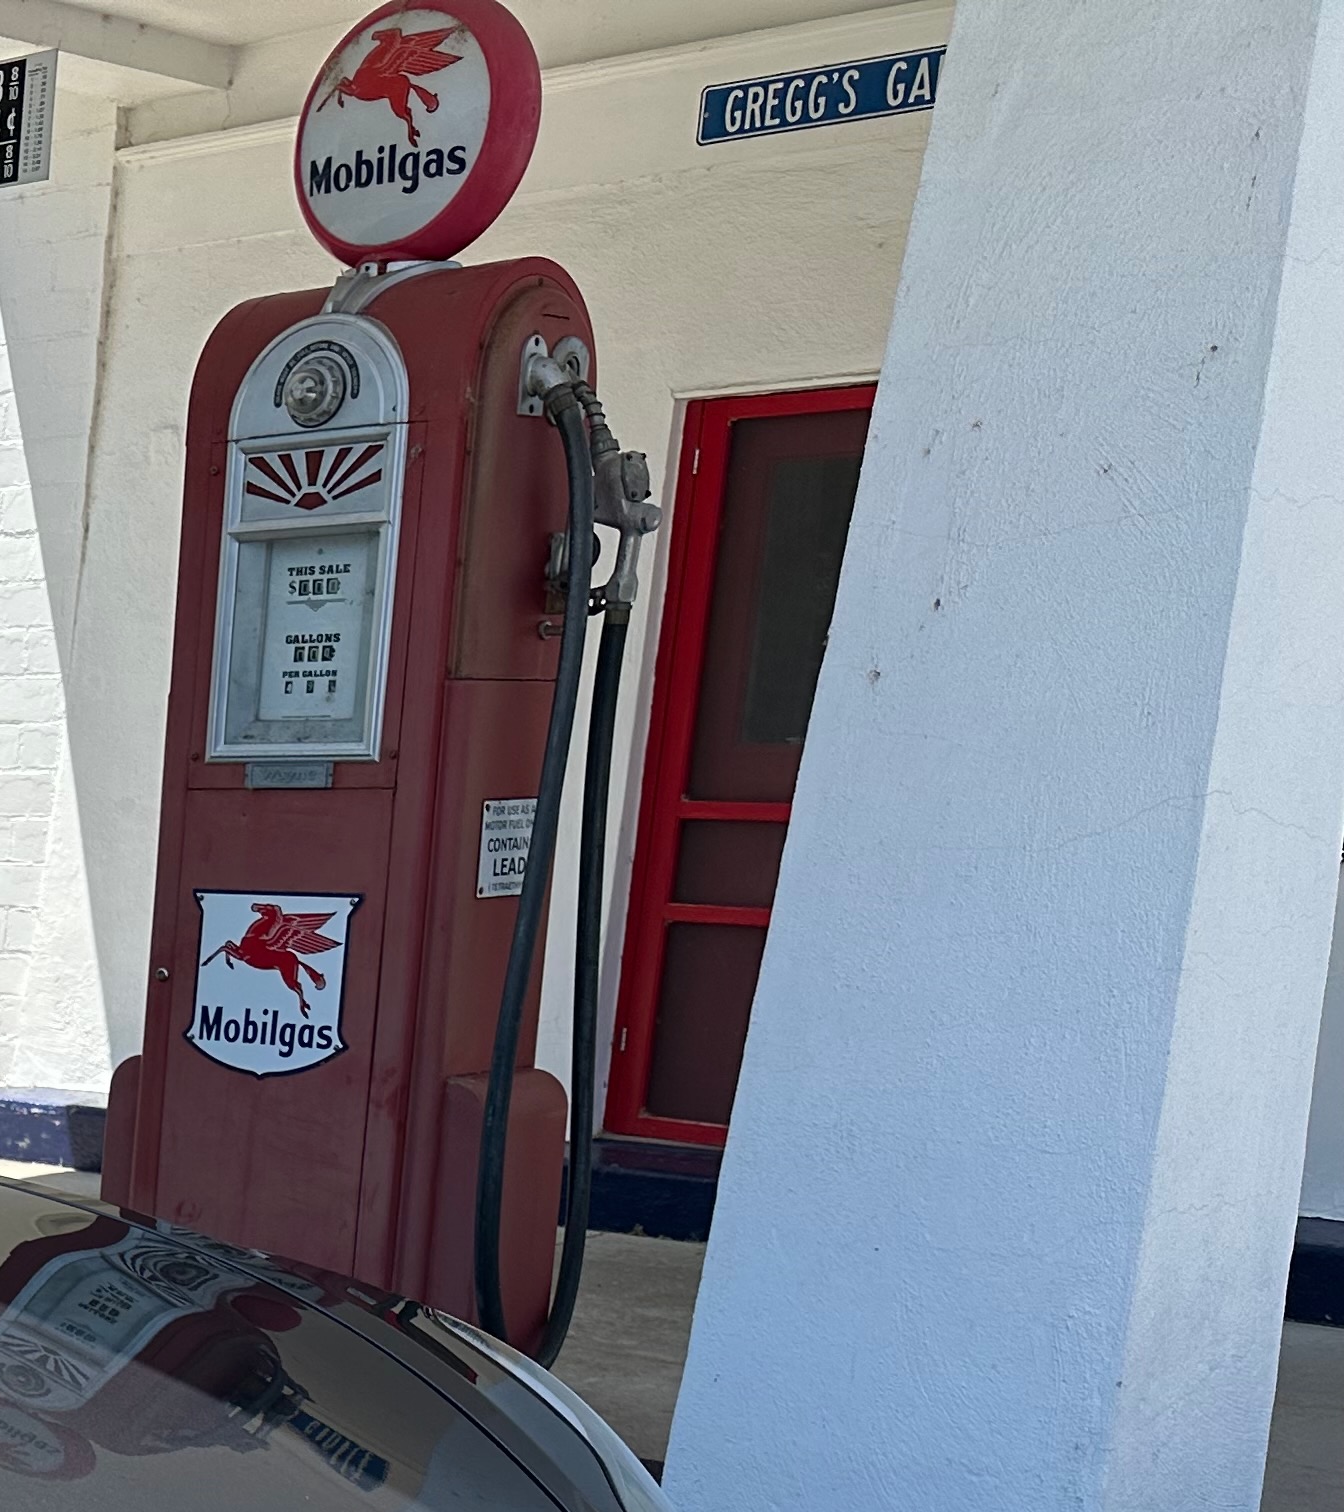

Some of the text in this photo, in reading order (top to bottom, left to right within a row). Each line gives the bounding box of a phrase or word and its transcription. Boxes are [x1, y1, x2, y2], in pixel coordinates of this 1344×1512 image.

[11, 66, 19, 80] 8
[725, 54, 944, 133] GREGG'S GA
[309, 144, 466, 198] Mobilgas
[287, 564, 351, 577] THIS SALE
[285, 633, 341, 644] GALLONS
[302, 670, 337, 678] GALLON
[493, 805, 506, 816] FOR
[507, 805, 519, 816] USE
[521, 804, 530, 814] AS
[485, 820, 507, 830] MOTOR
[508, 819, 524, 830] FUEL
[487, 836, 530, 853] CONTAIN
[493, 857, 527, 877] LEAD
[198, 1006, 334, 1058] Mobilgas
